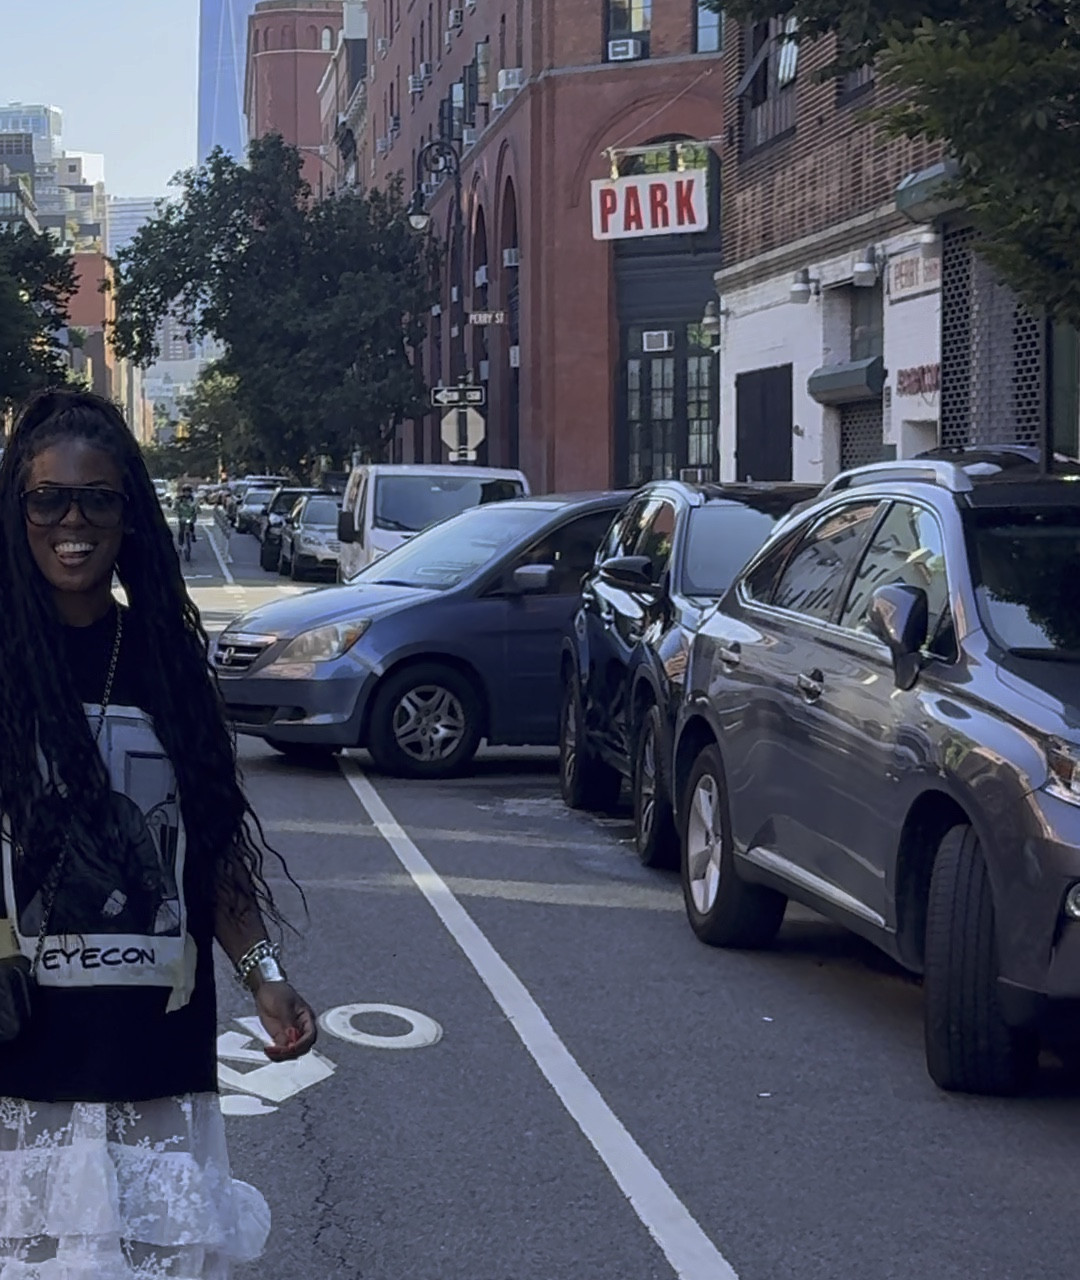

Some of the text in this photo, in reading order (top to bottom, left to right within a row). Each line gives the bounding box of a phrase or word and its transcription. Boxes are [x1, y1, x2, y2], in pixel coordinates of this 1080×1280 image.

[599, 179, 696, 234] PARK
[469, 312, 492, 324] PERRY
[42, 947, 155, 970] EYECON
